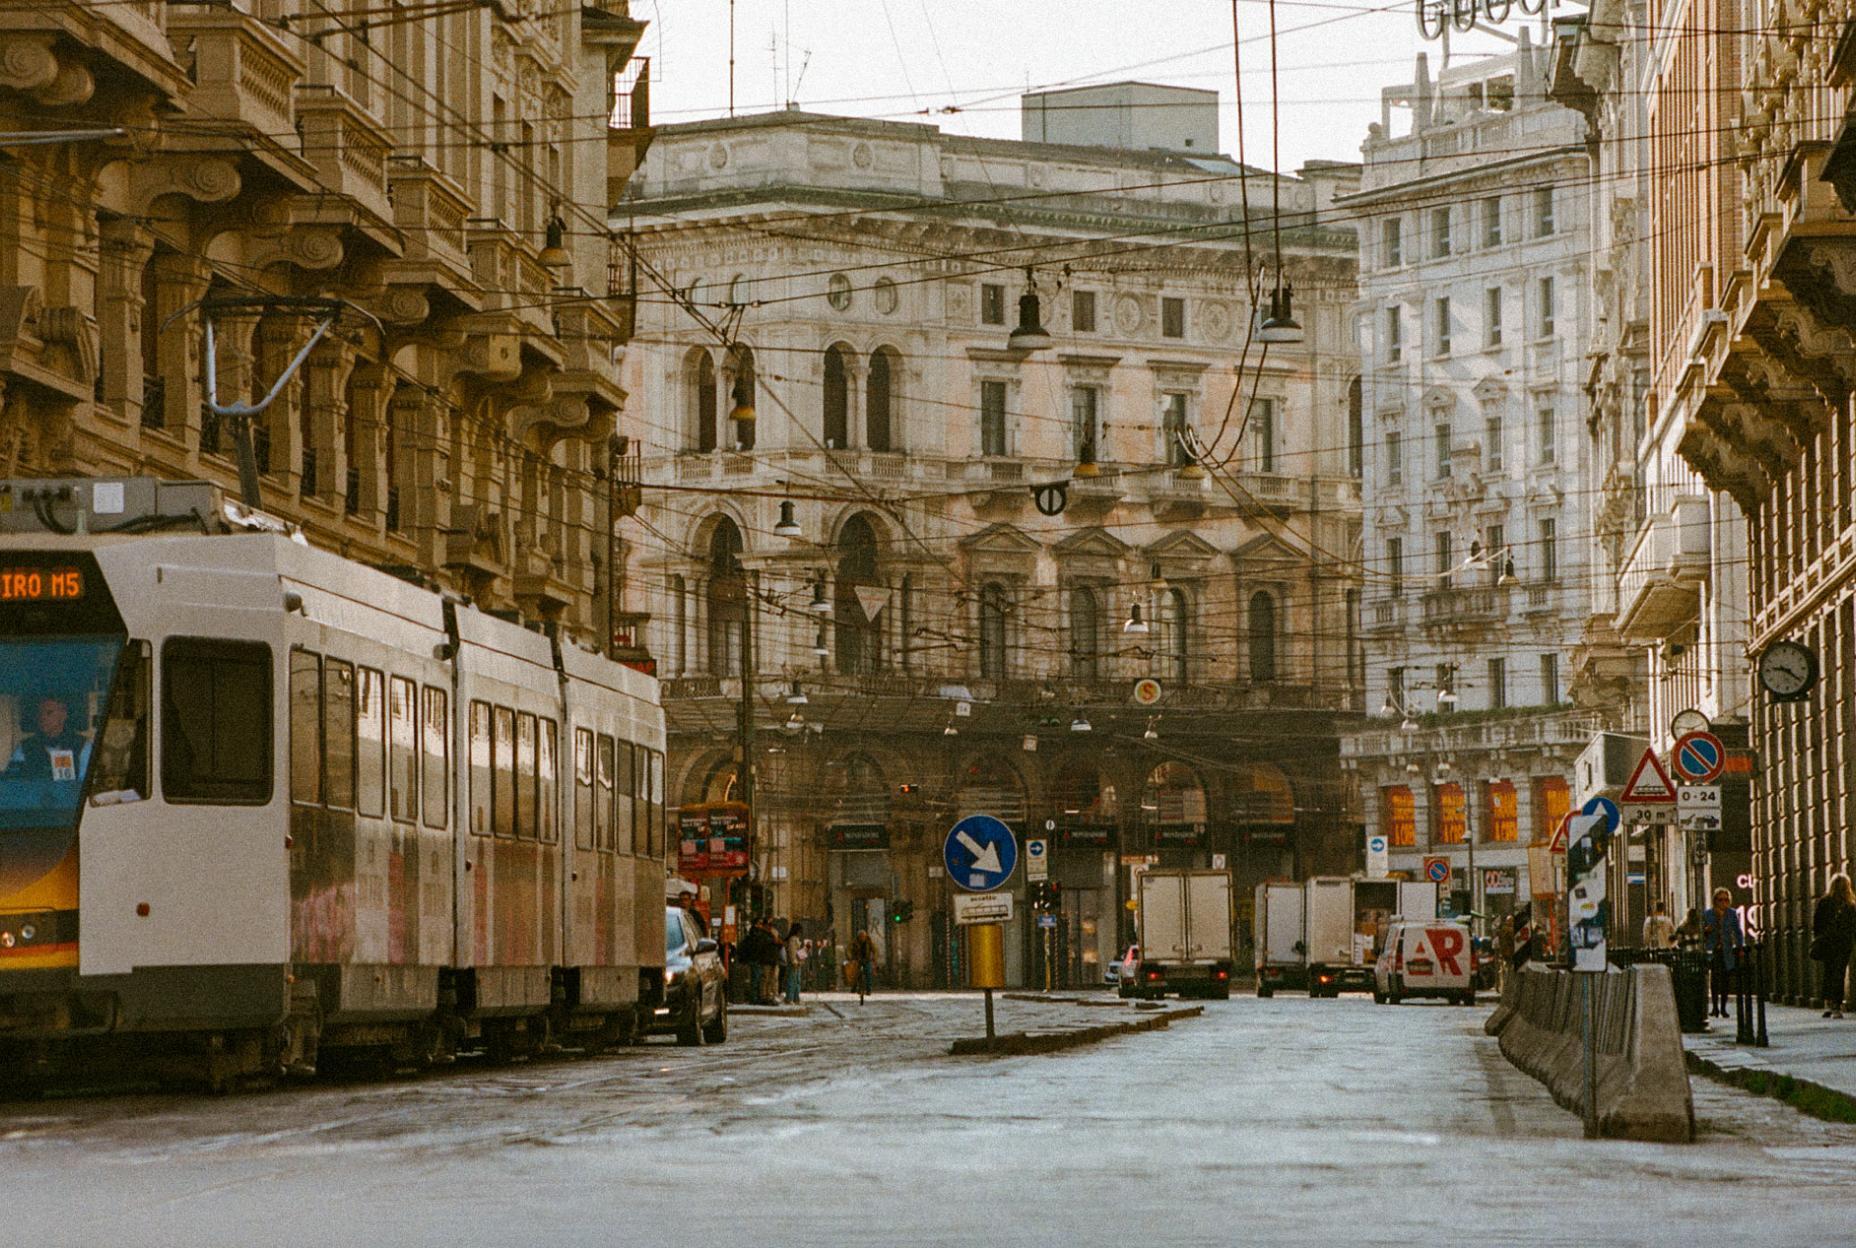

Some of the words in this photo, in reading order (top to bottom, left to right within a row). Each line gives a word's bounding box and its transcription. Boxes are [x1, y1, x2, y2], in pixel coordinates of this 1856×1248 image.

[1, 573, 42, 598] IRO
[51, 572, 80, 597] M5
[1636, 809, 1651, 821] 30
